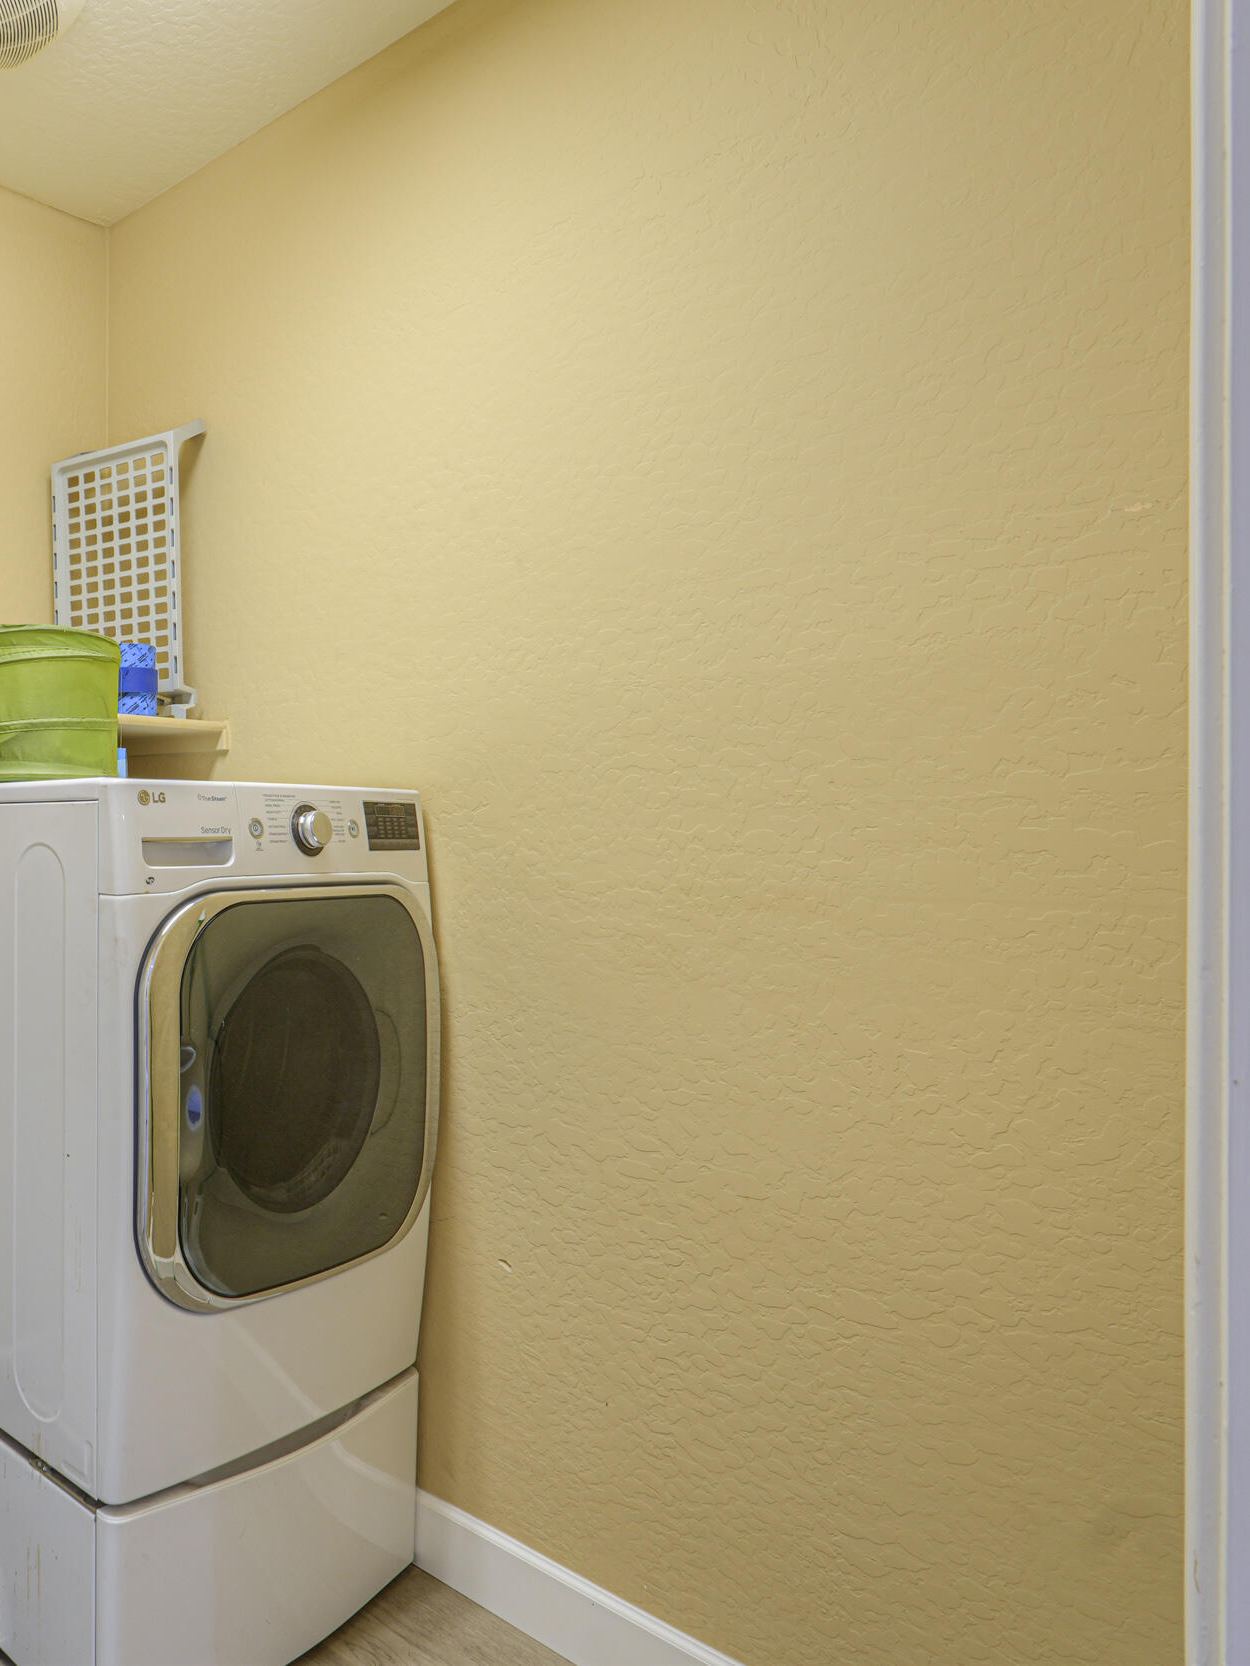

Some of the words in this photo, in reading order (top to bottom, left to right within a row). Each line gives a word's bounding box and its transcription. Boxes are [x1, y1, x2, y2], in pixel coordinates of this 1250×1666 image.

[151, 791, 167, 804] LG
[200, 826, 220, 834] Sensor
[220, 825, 231, 835] Dry
